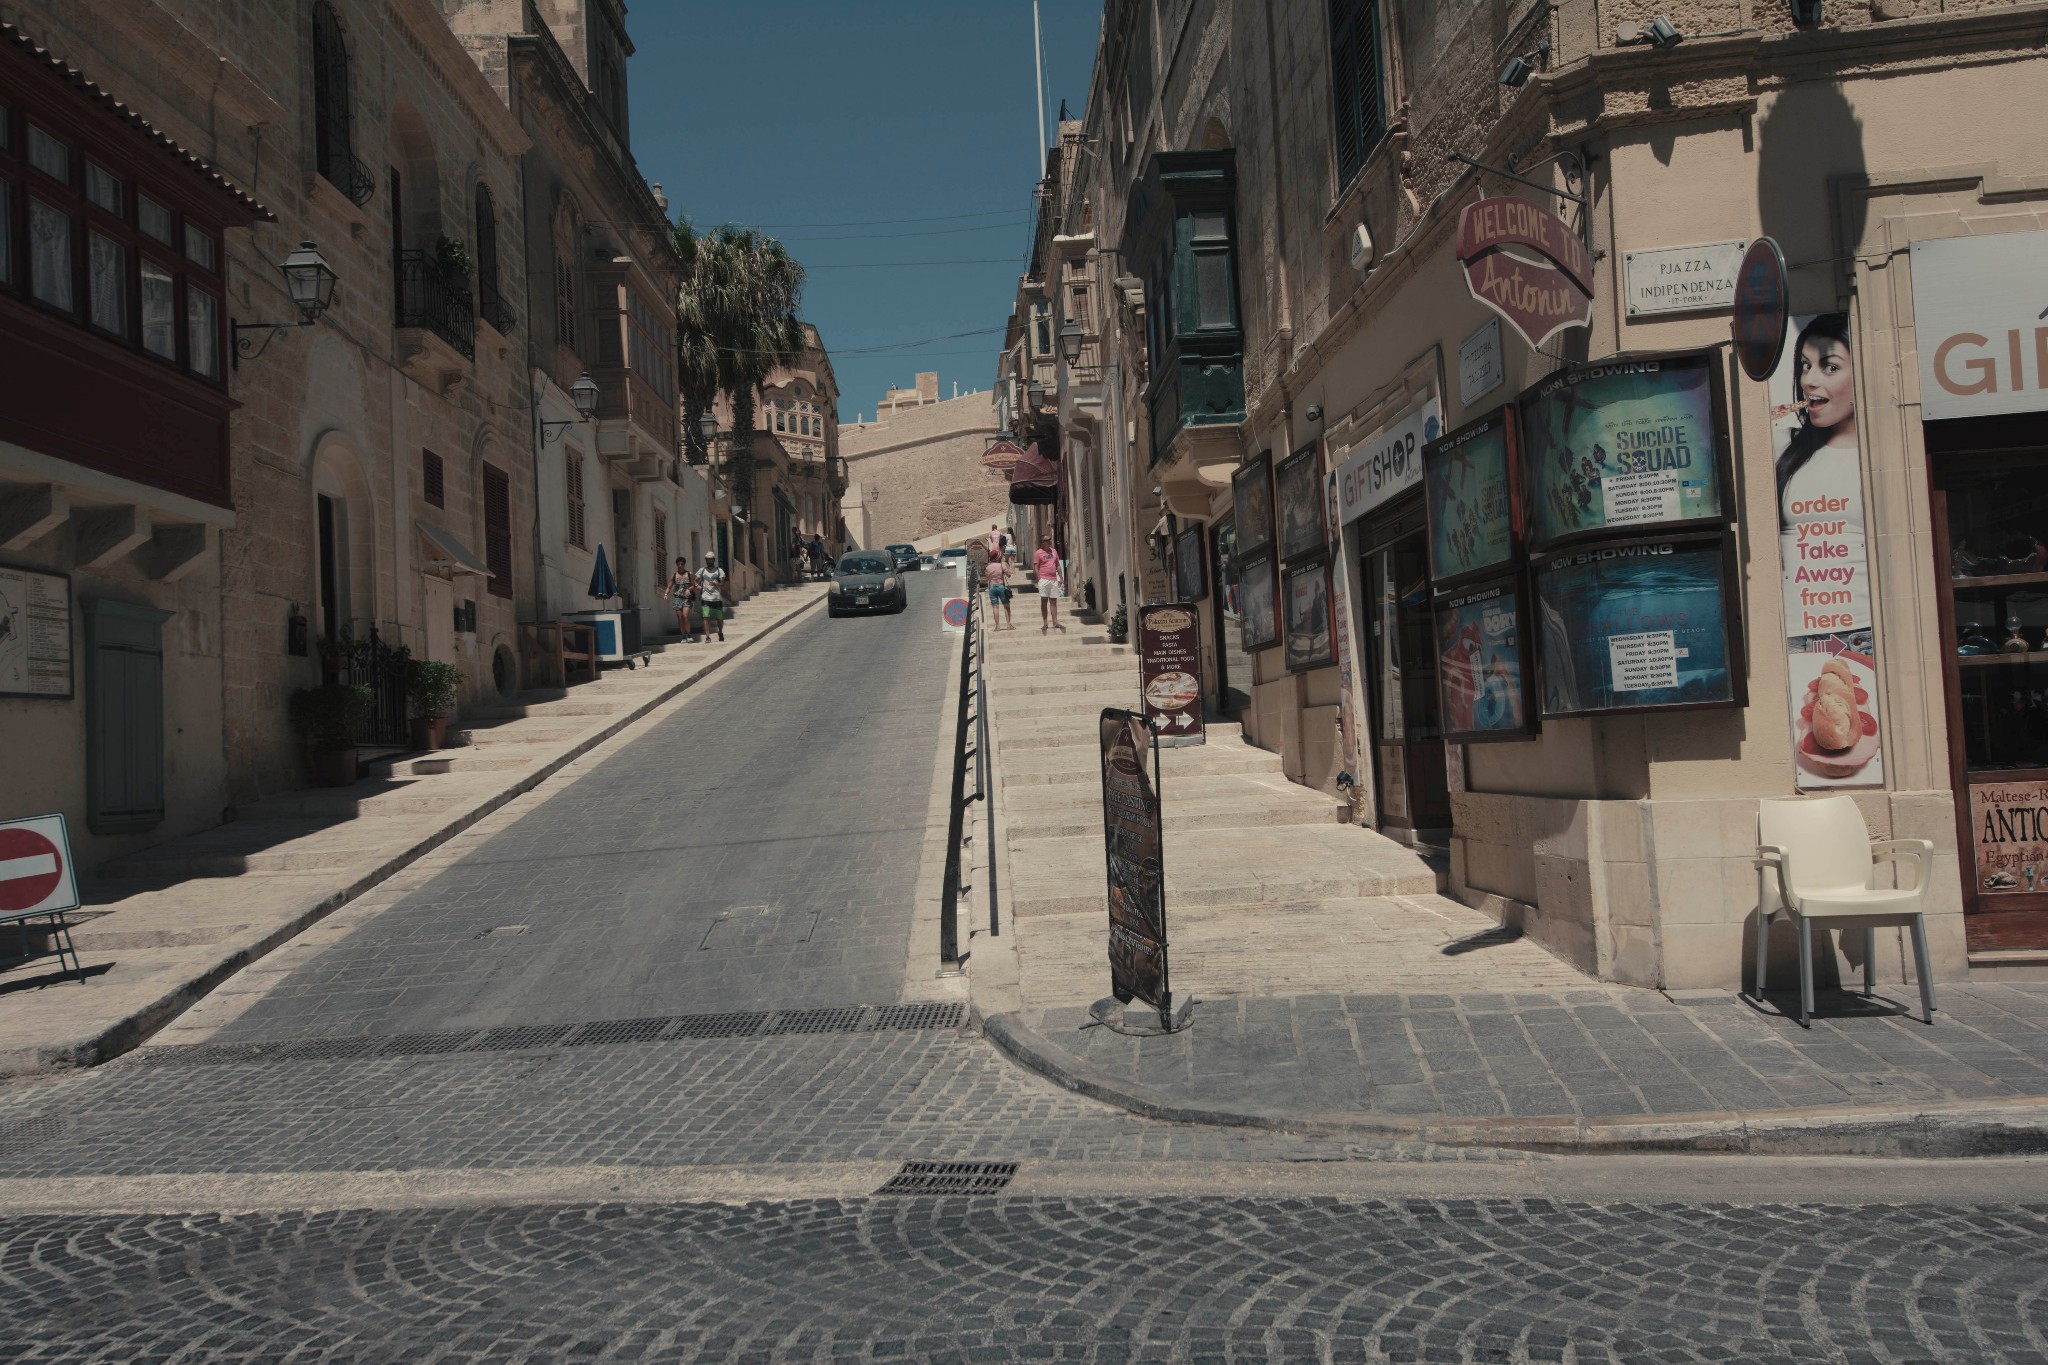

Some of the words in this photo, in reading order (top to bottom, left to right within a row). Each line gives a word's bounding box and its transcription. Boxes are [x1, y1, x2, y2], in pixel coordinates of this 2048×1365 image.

[1473, 203, 1550, 248] WELCOME
[1560, 227, 1581, 274] TO
[1660, 260, 1713, 275] PJAZZA
[1640, 279, 1734, 299] INDIPENDENZA
[1540, 378, 1564, 399] NOW
[1567, 361, 1661, 385] SHOWING
[1439, 439, 1455, 455] NOW
[1456, 422, 1489, 446] SHOWING
[1616, 425, 1688, 451] SUICIDE
[1616, 446, 1692, 475] SQUAD
[1608, 483, 1637, 491] SATURDAY
[1615, 475, 1636, 483] FRIDAY
[1615, 490, 1638, 498] SUNDAY
[1614, 506, 1639, 514] TUESDAY
[1790, 494, 1850, 515] order
[1606, 514, 1641, 523] WEDNESDAY
[1796, 520, 1846, 542] your
[1551, 555, 1572, 571] NOW
[1576, 543, 1674, 564] SHOWING
[1796, 540, 1849, 560] Take
[1794, 565, 1855, 585] Away
[1449, 598, 1465, 608] NOW
[1467, 588, 1501, 604] SHOWING
[1800, 588, 1852, 606] from
[1803, 611, 1853, 629] here
[1610, 634, 1644, 643] WEDNESDAY
[1146, 656, 1180, 664] TRADITIONAL
[1617, 658, 1647, 666] SATURDAY
